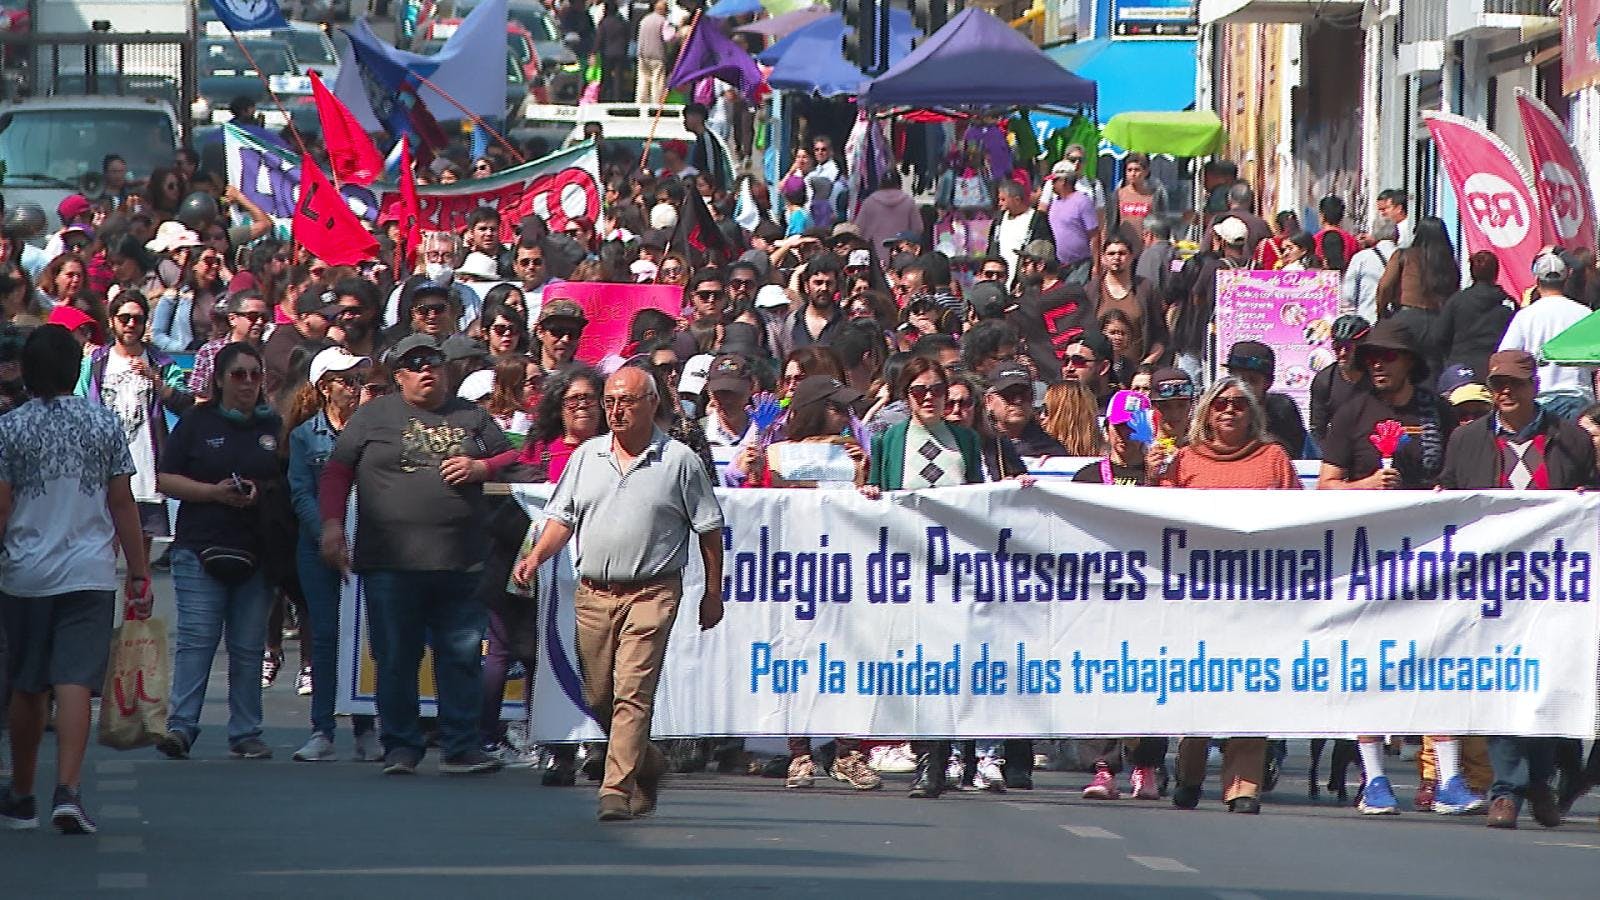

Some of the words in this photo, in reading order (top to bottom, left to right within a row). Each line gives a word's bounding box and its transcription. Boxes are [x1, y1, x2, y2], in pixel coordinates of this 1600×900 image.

[866, 526, 912, 603] de
[926, 526, 1149, 603] Profesores
[1162, 527, 1335, 601] Comunal
[1347, 525, 1591, 618] Antofagasta
[751, 641, 809, 694] Por
[819, 642, 847, 694] la
[857, 643, 962, 696] unidad
[971, 642, 1008, 696] de
[1017, 641, 1062, 695] los
[1071, 640, 1281, 706] trabajadores
[1291, 639, 1329, 692] de
[1340, 639, 1368, 692] la
[1379, 639, 1540, 692] Educación
